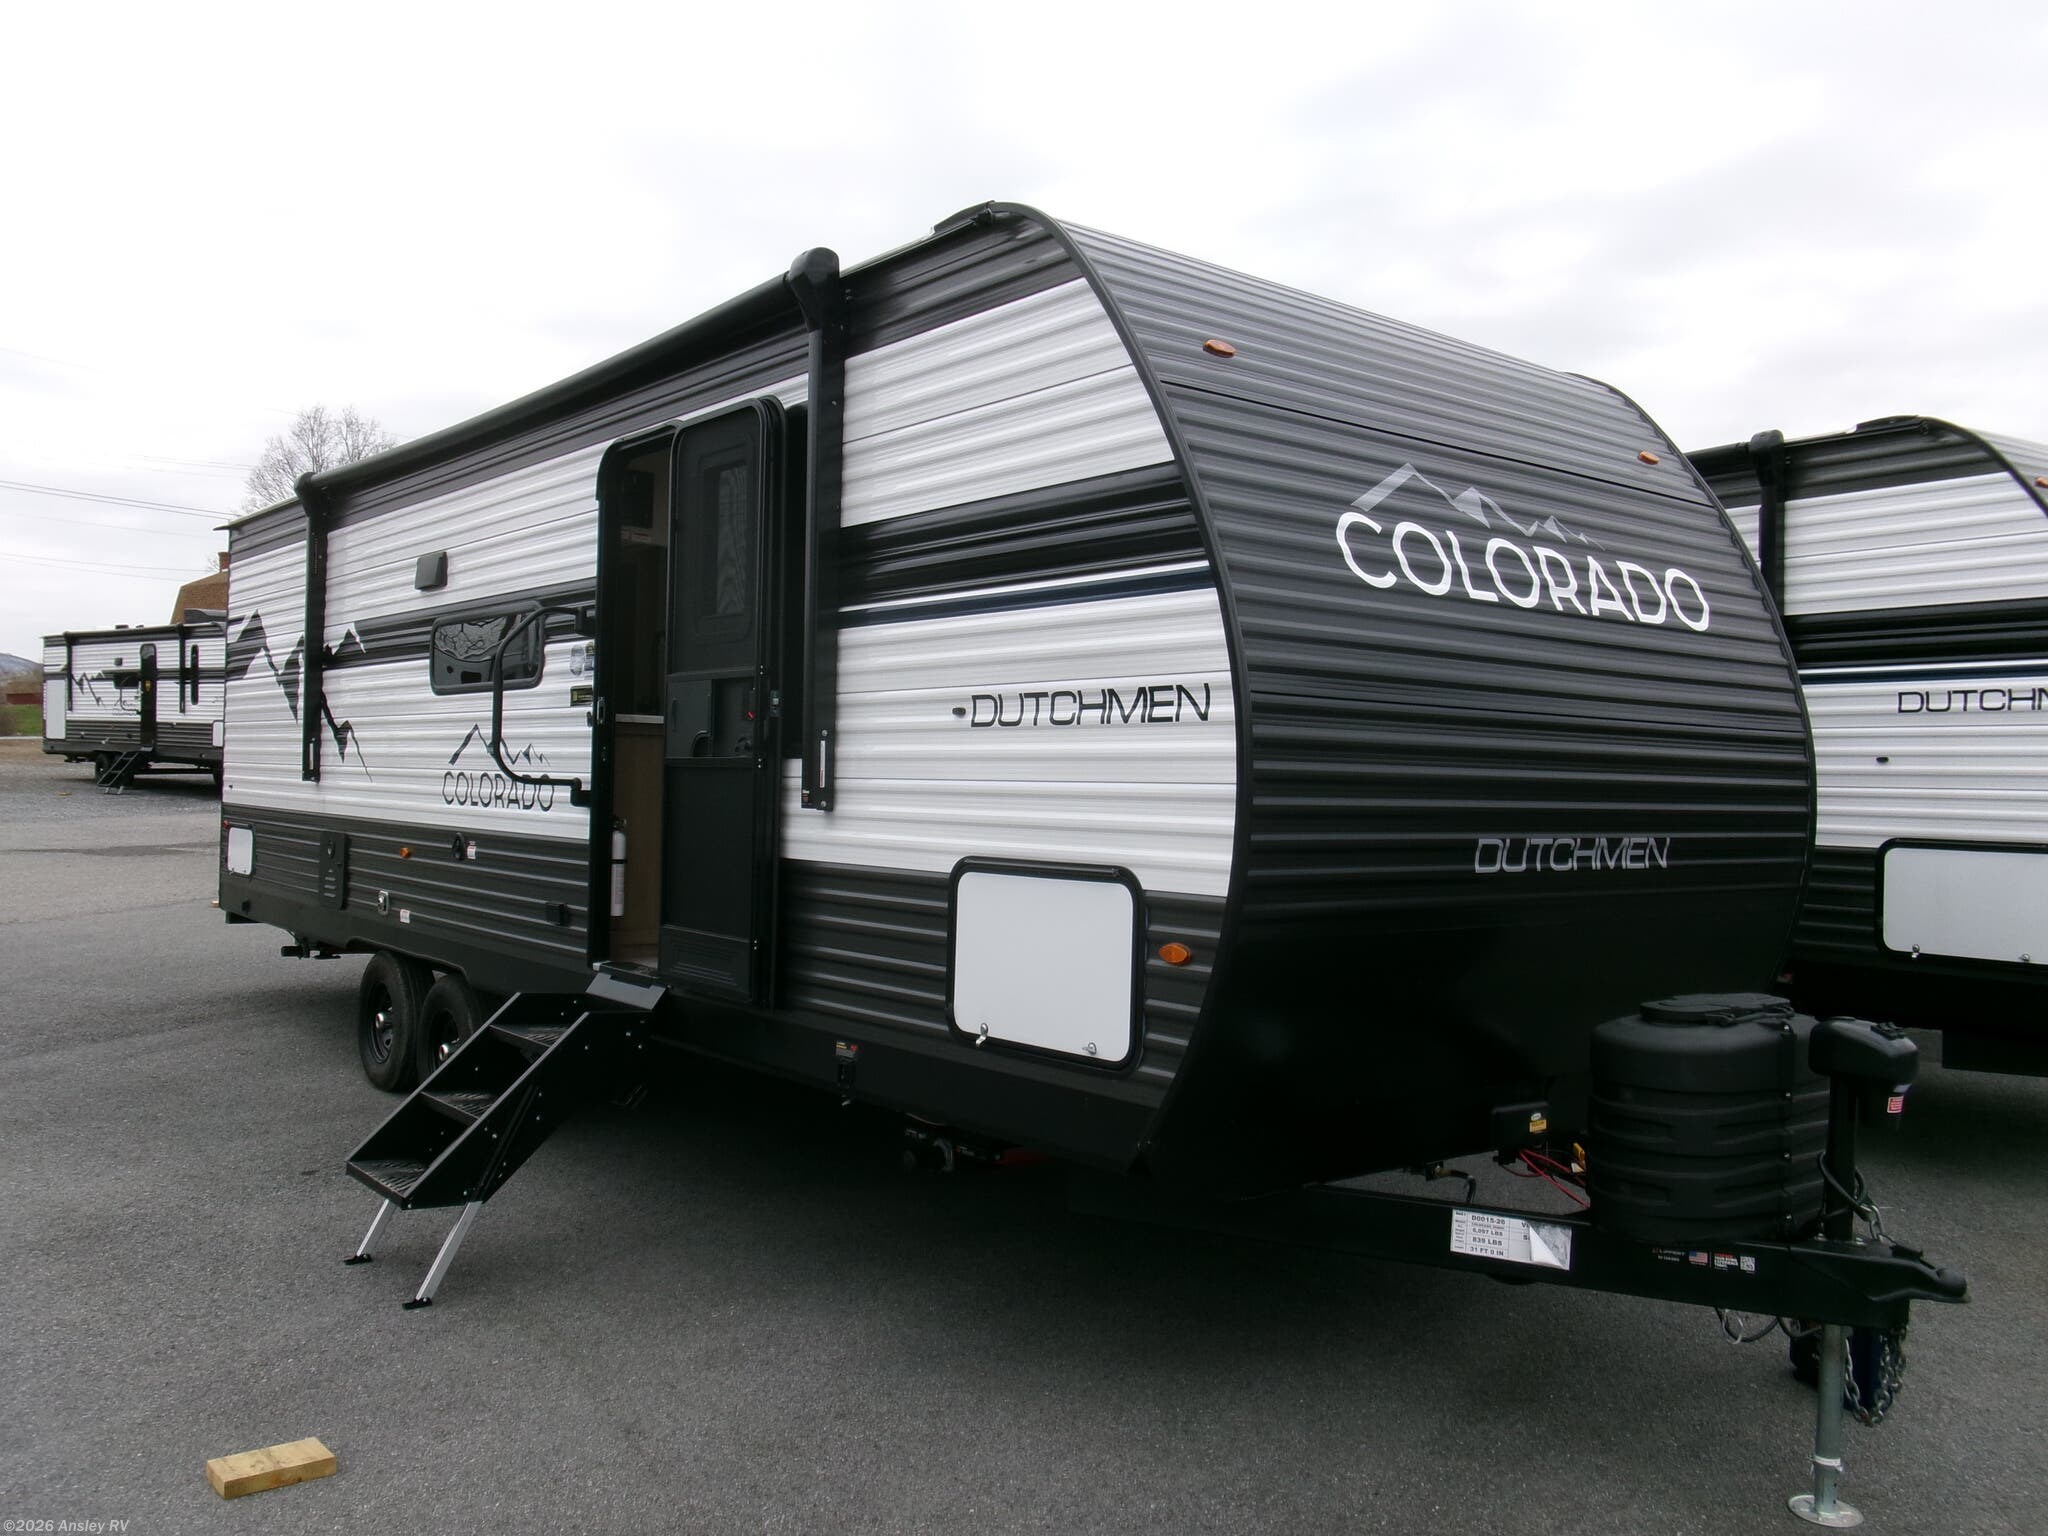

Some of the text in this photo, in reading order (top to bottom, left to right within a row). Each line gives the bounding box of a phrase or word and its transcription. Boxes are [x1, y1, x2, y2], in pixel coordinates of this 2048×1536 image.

[1336, 511, 1710, 632] COLORADO
[970, 682, 1211, 728] DUTCHMEN
[442, 770, 555, 812] COLORADO
[1474, 836, 1671, 874] DUTCHMEN
